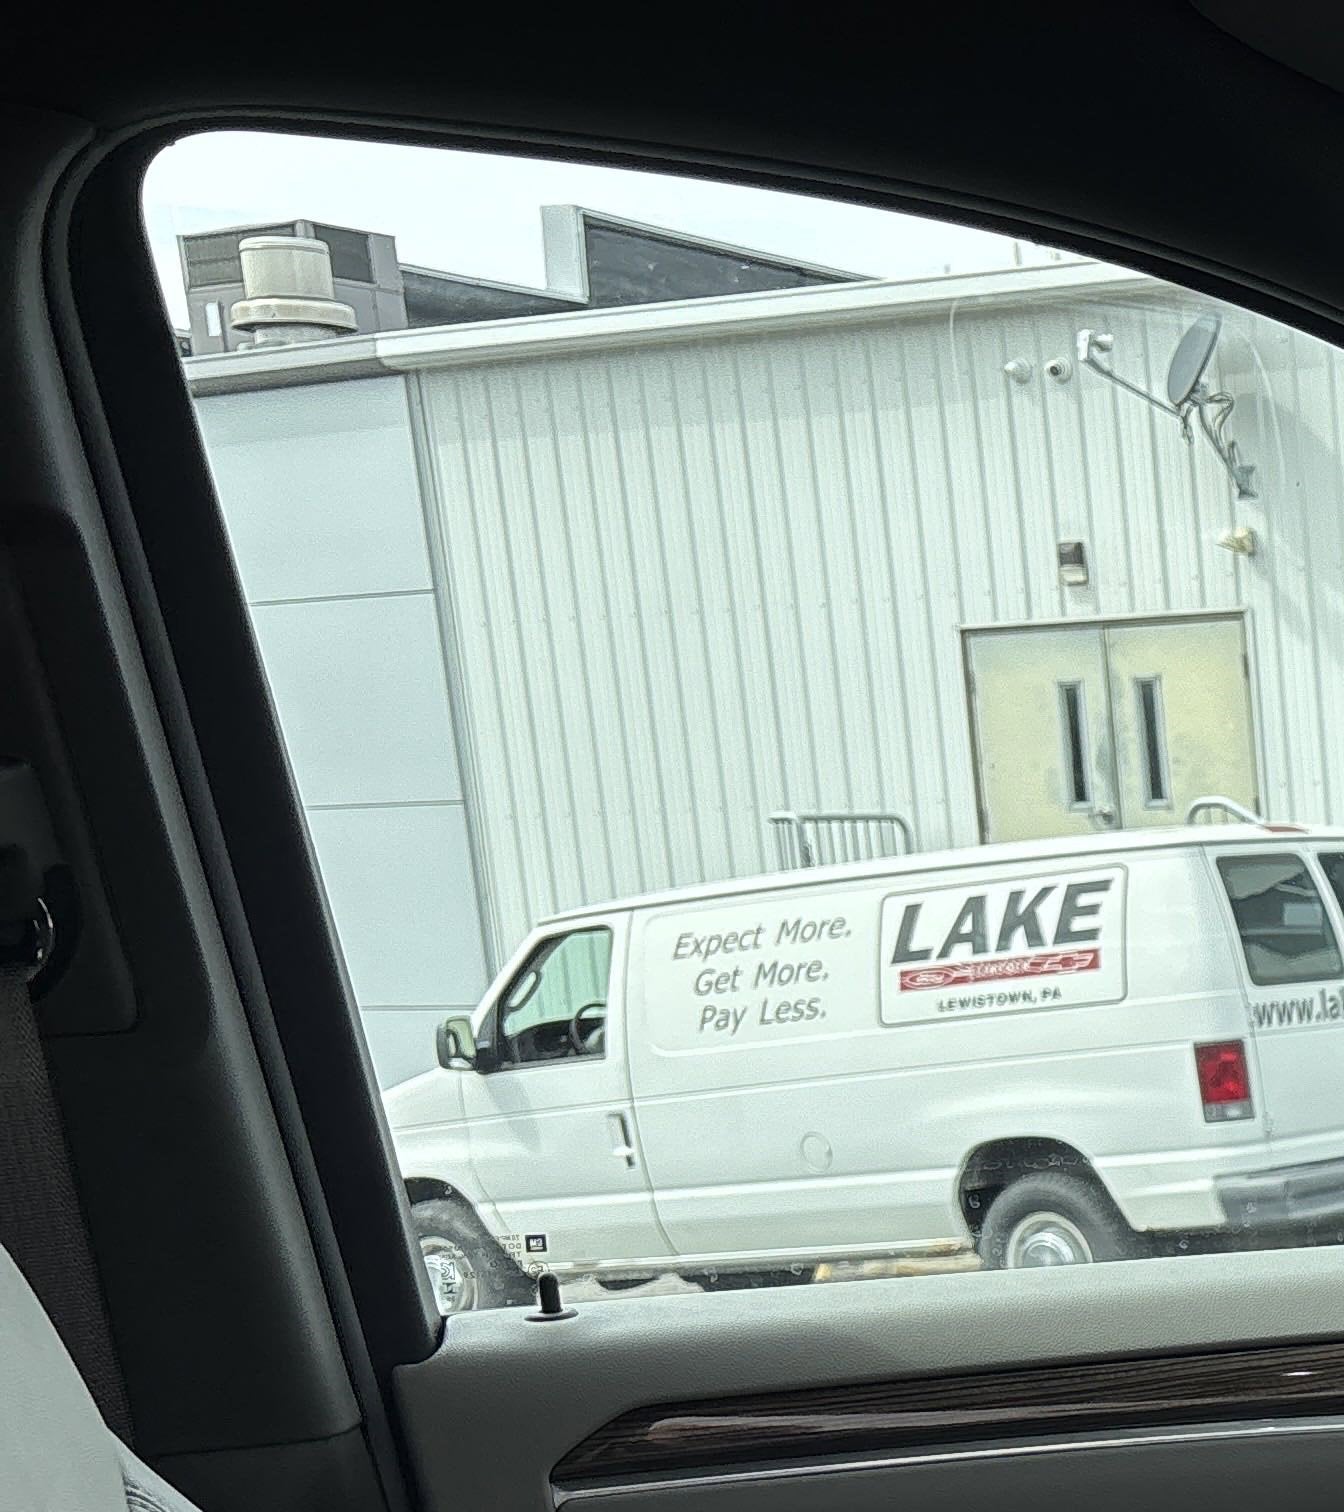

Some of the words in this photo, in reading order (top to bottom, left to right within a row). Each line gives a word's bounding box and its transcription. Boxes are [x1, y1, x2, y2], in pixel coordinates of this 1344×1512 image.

[672, 924, 765, 962] Expect
[774, 914, 852, 945] More.
[890, 878, 1115, 965] LAKE
[694, 968, 740, 997] Get
[1040, 987, 1062, 1001] PA
[699, 1003, 746, 1036] Pay
[759, 995, 827, 1026] Less.
